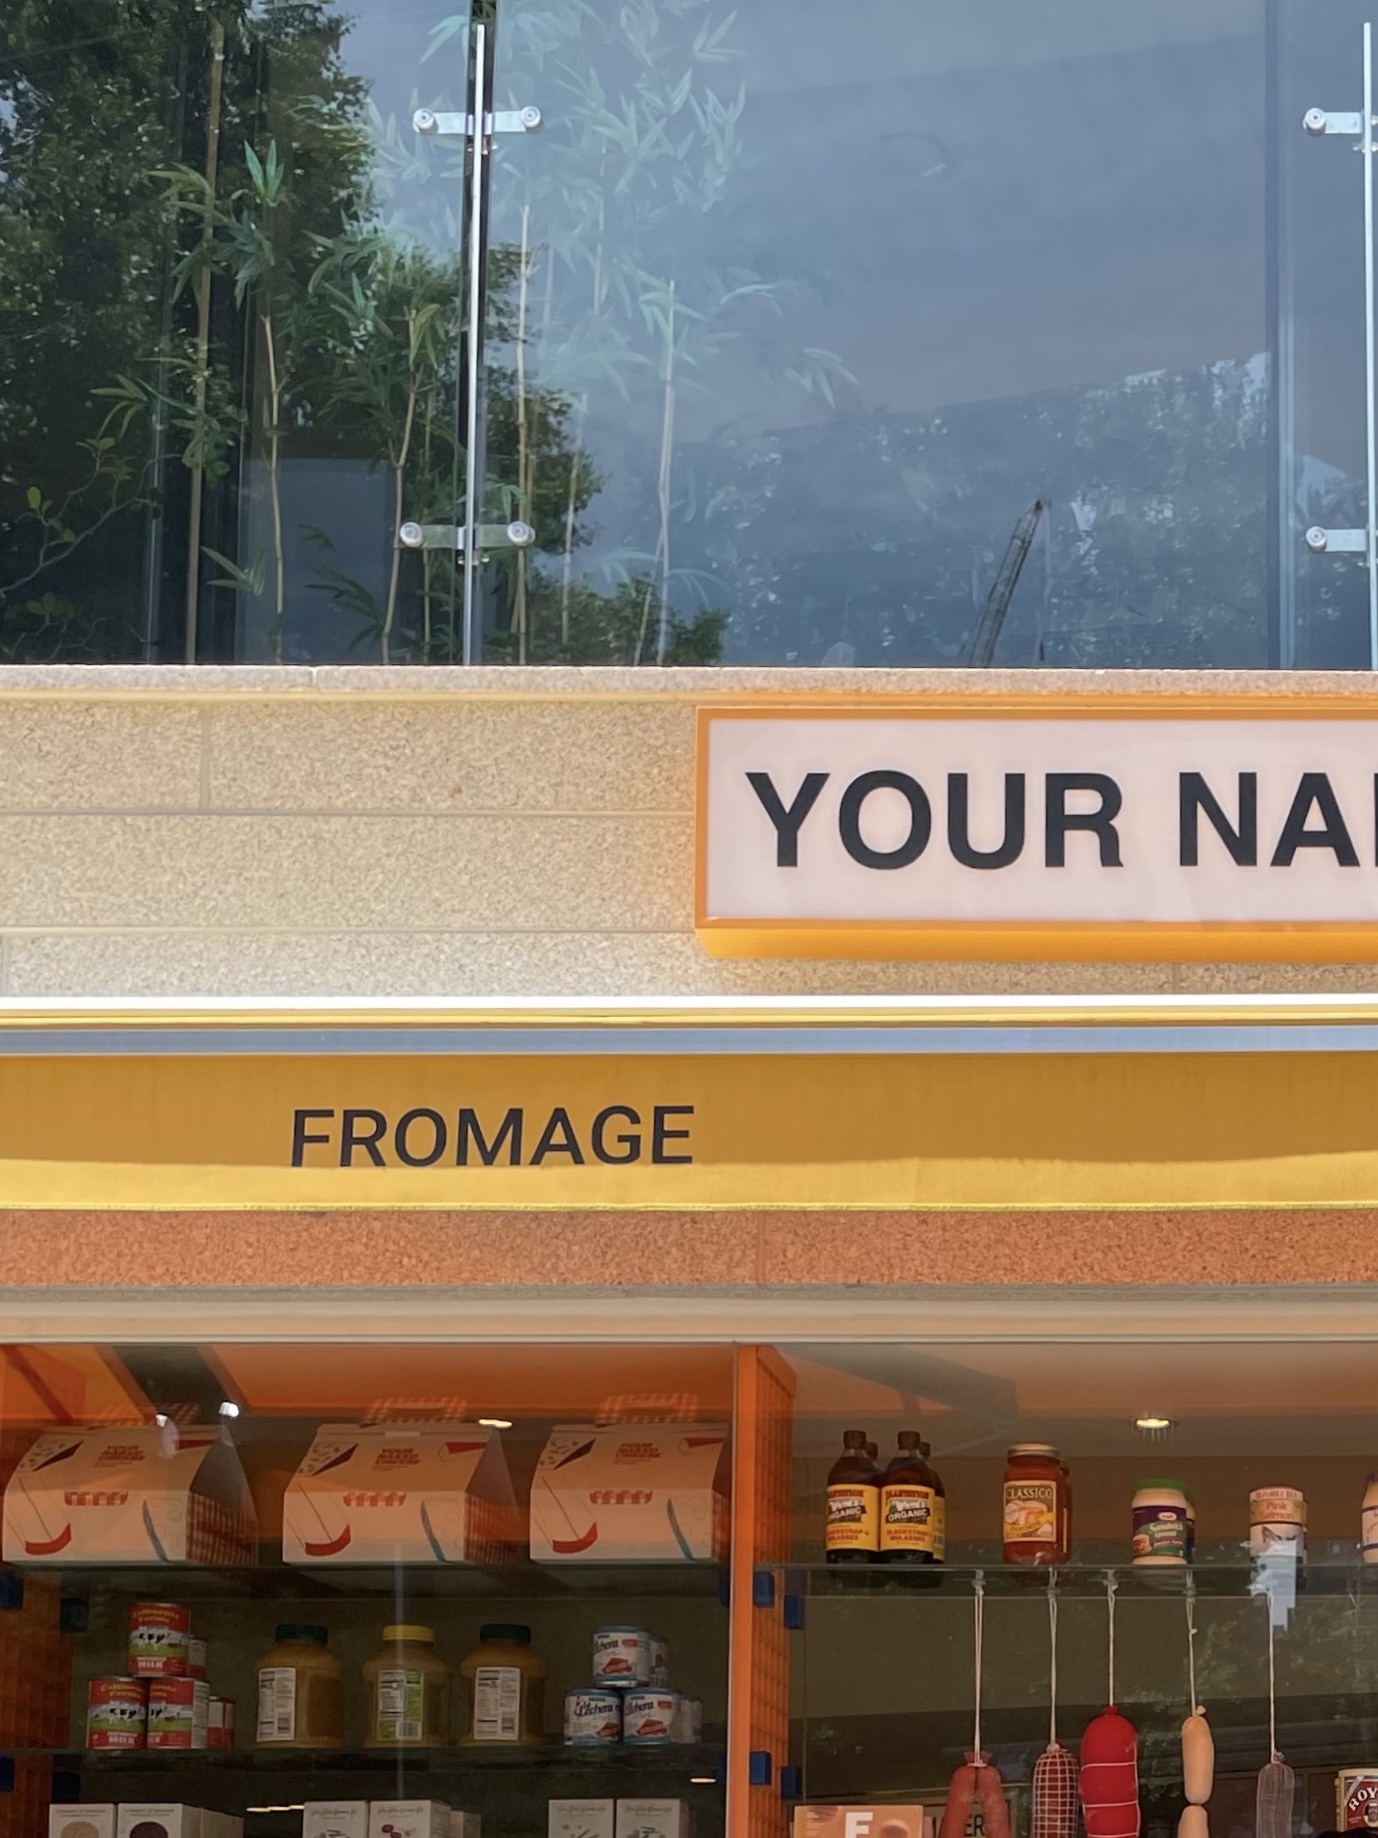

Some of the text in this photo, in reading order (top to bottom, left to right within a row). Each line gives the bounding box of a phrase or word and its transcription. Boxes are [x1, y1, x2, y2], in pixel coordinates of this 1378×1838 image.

[746, 769, 1123, 870] YOUR
[290, 1105, 695, 1168] FROMAGE
[1006, 1488, 1052, 1500] CLASSICO
[1265, 1502, 1288, 1511] Pink
[888, 1508, 928, 1523] ORGANIC
